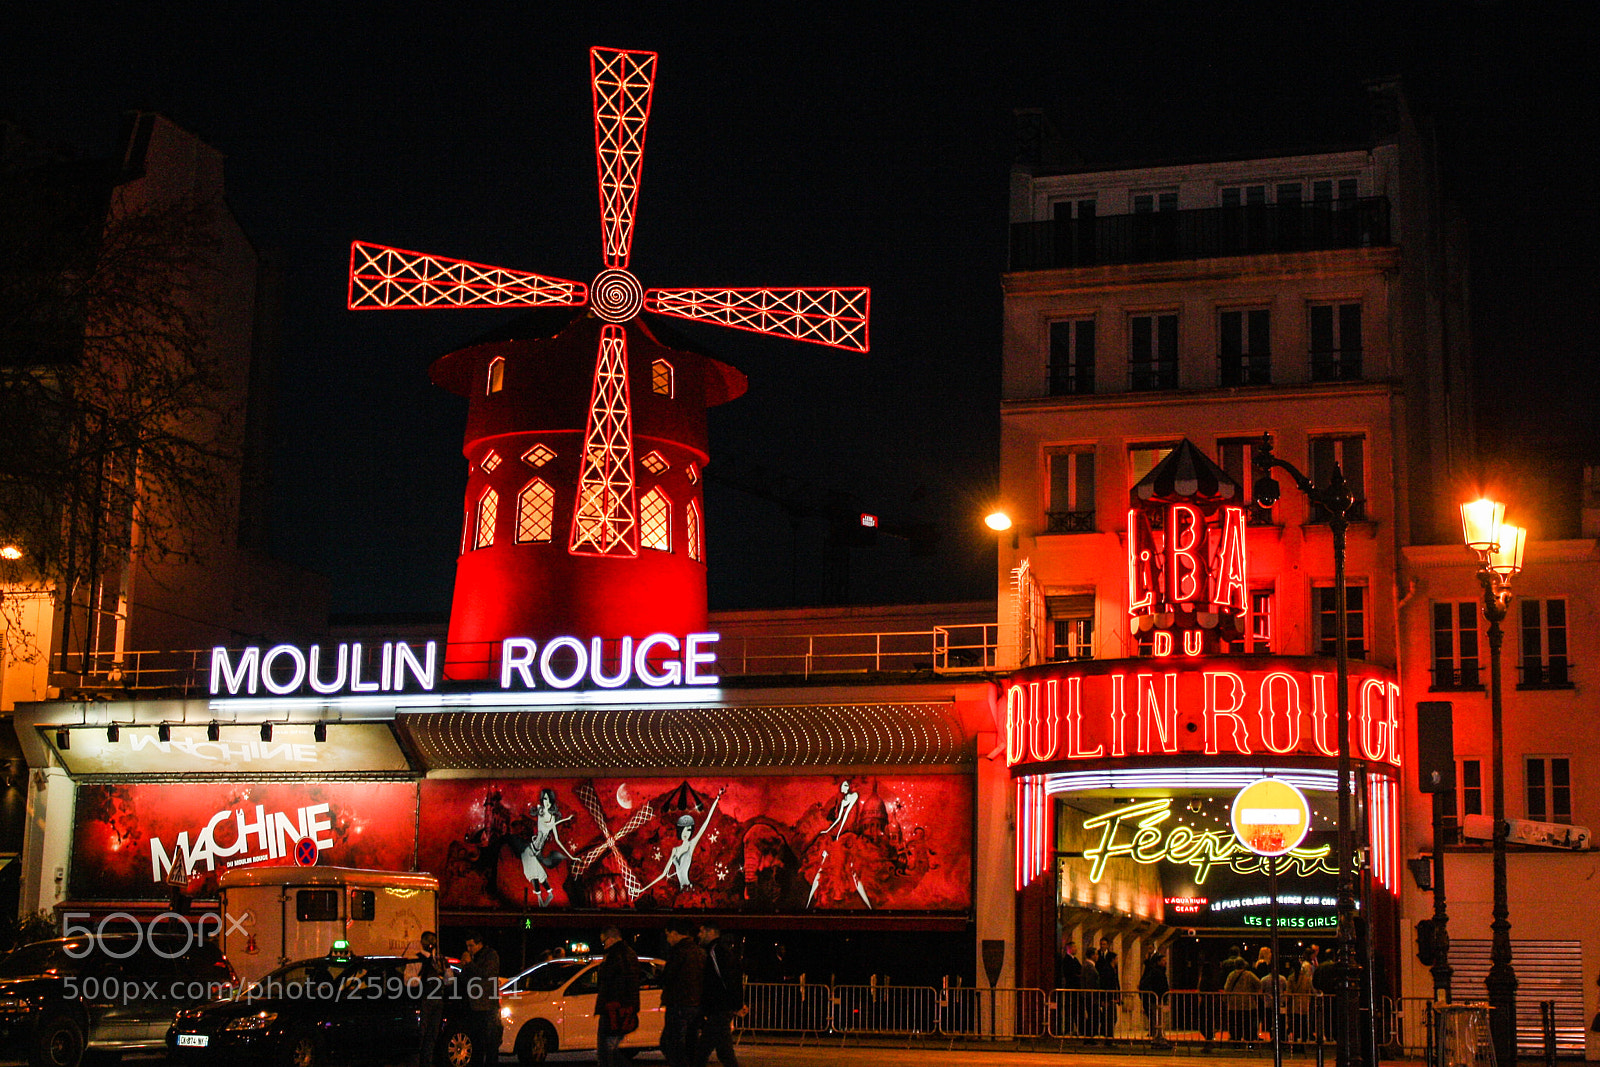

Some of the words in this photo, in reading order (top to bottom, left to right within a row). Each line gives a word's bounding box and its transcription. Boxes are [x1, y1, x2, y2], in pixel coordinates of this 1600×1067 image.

[1154, 630, 1203, 657] DU
[210, 640, 437, 696] MOULIN
[500, 632, 720, 690] ROUGE
[1202, 671, 1402, 767] ROUGE
[149, 802, 335, 883] MACHINE
[234, 857, 252, 867] MOULIN
[253, 854, 268, 863] ROUGE
[1222, 899, 1240, 909] PLUS
[1244, 915, 1262, 926] LES
[1307, 915, 1338, 928] GIRLS
